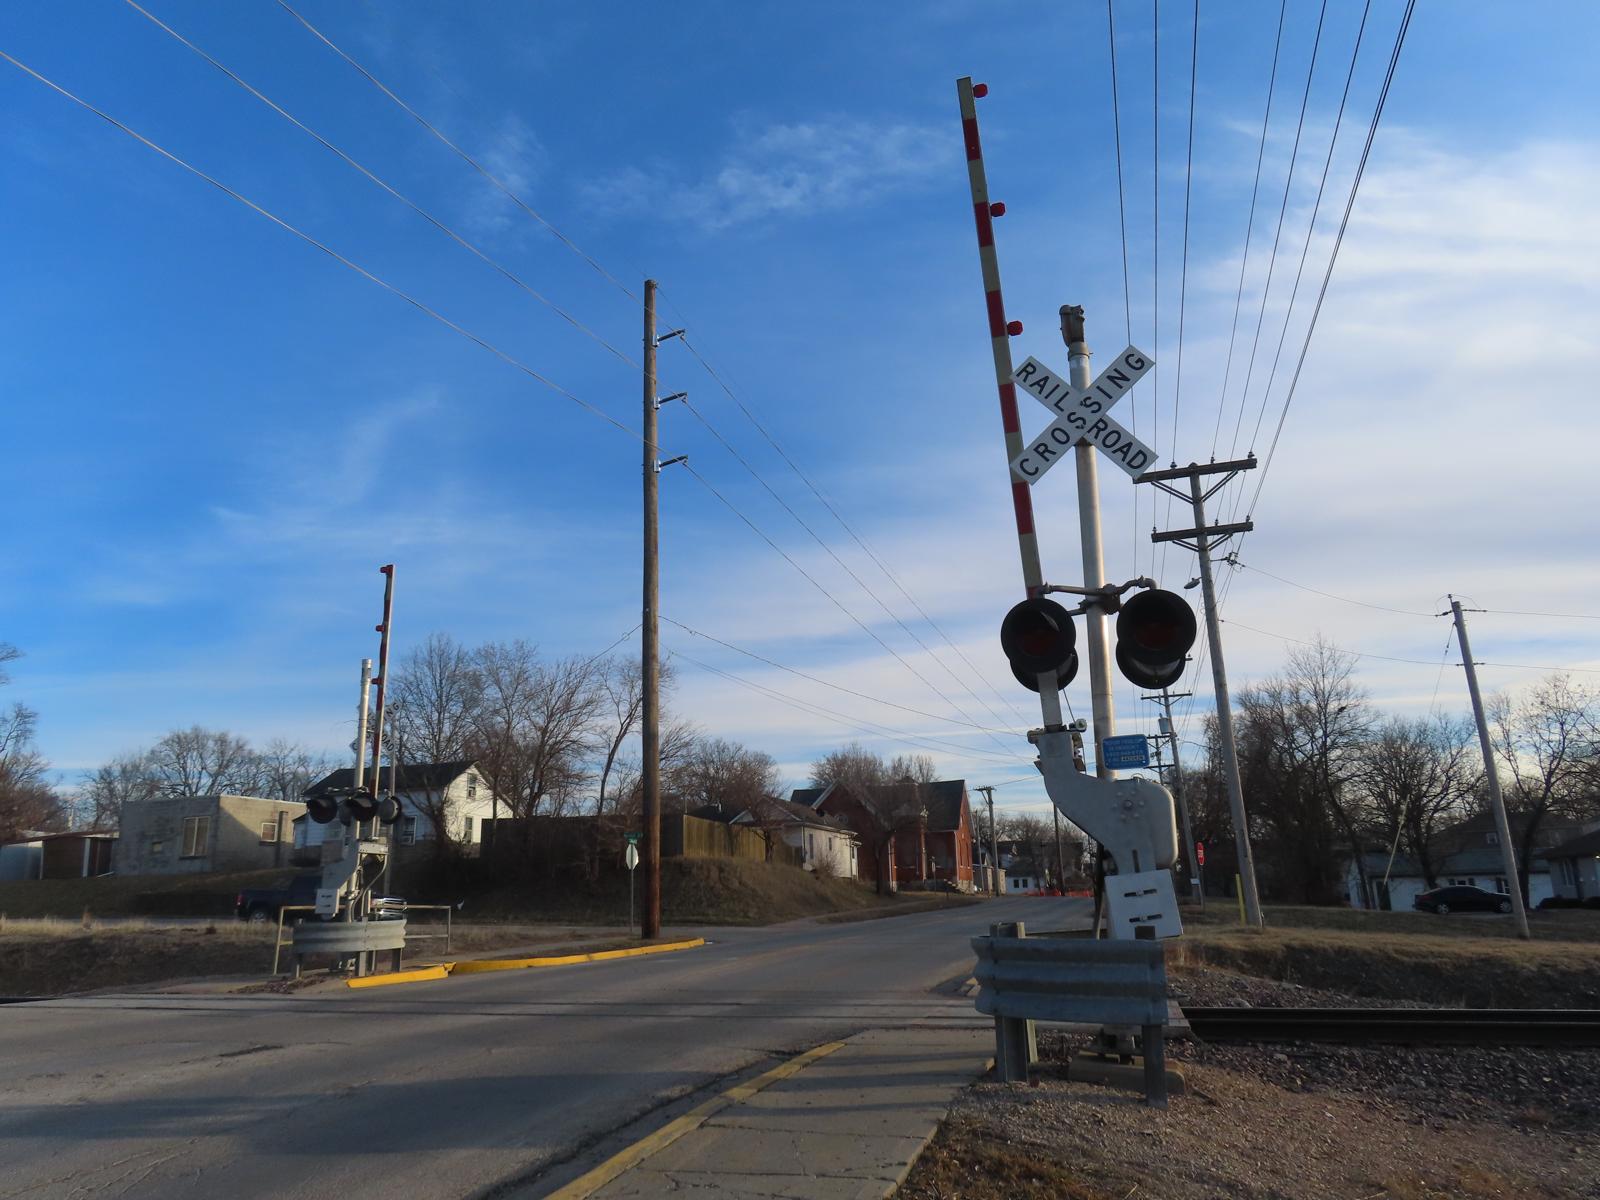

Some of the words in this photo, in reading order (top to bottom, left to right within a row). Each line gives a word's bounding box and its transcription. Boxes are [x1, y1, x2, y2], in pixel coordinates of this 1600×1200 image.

[1016, 362, 1070, 412] RAIL
[1087, 418, 1147, 469] ROAD
[1020, 354, 1145, 475] CROSSING
